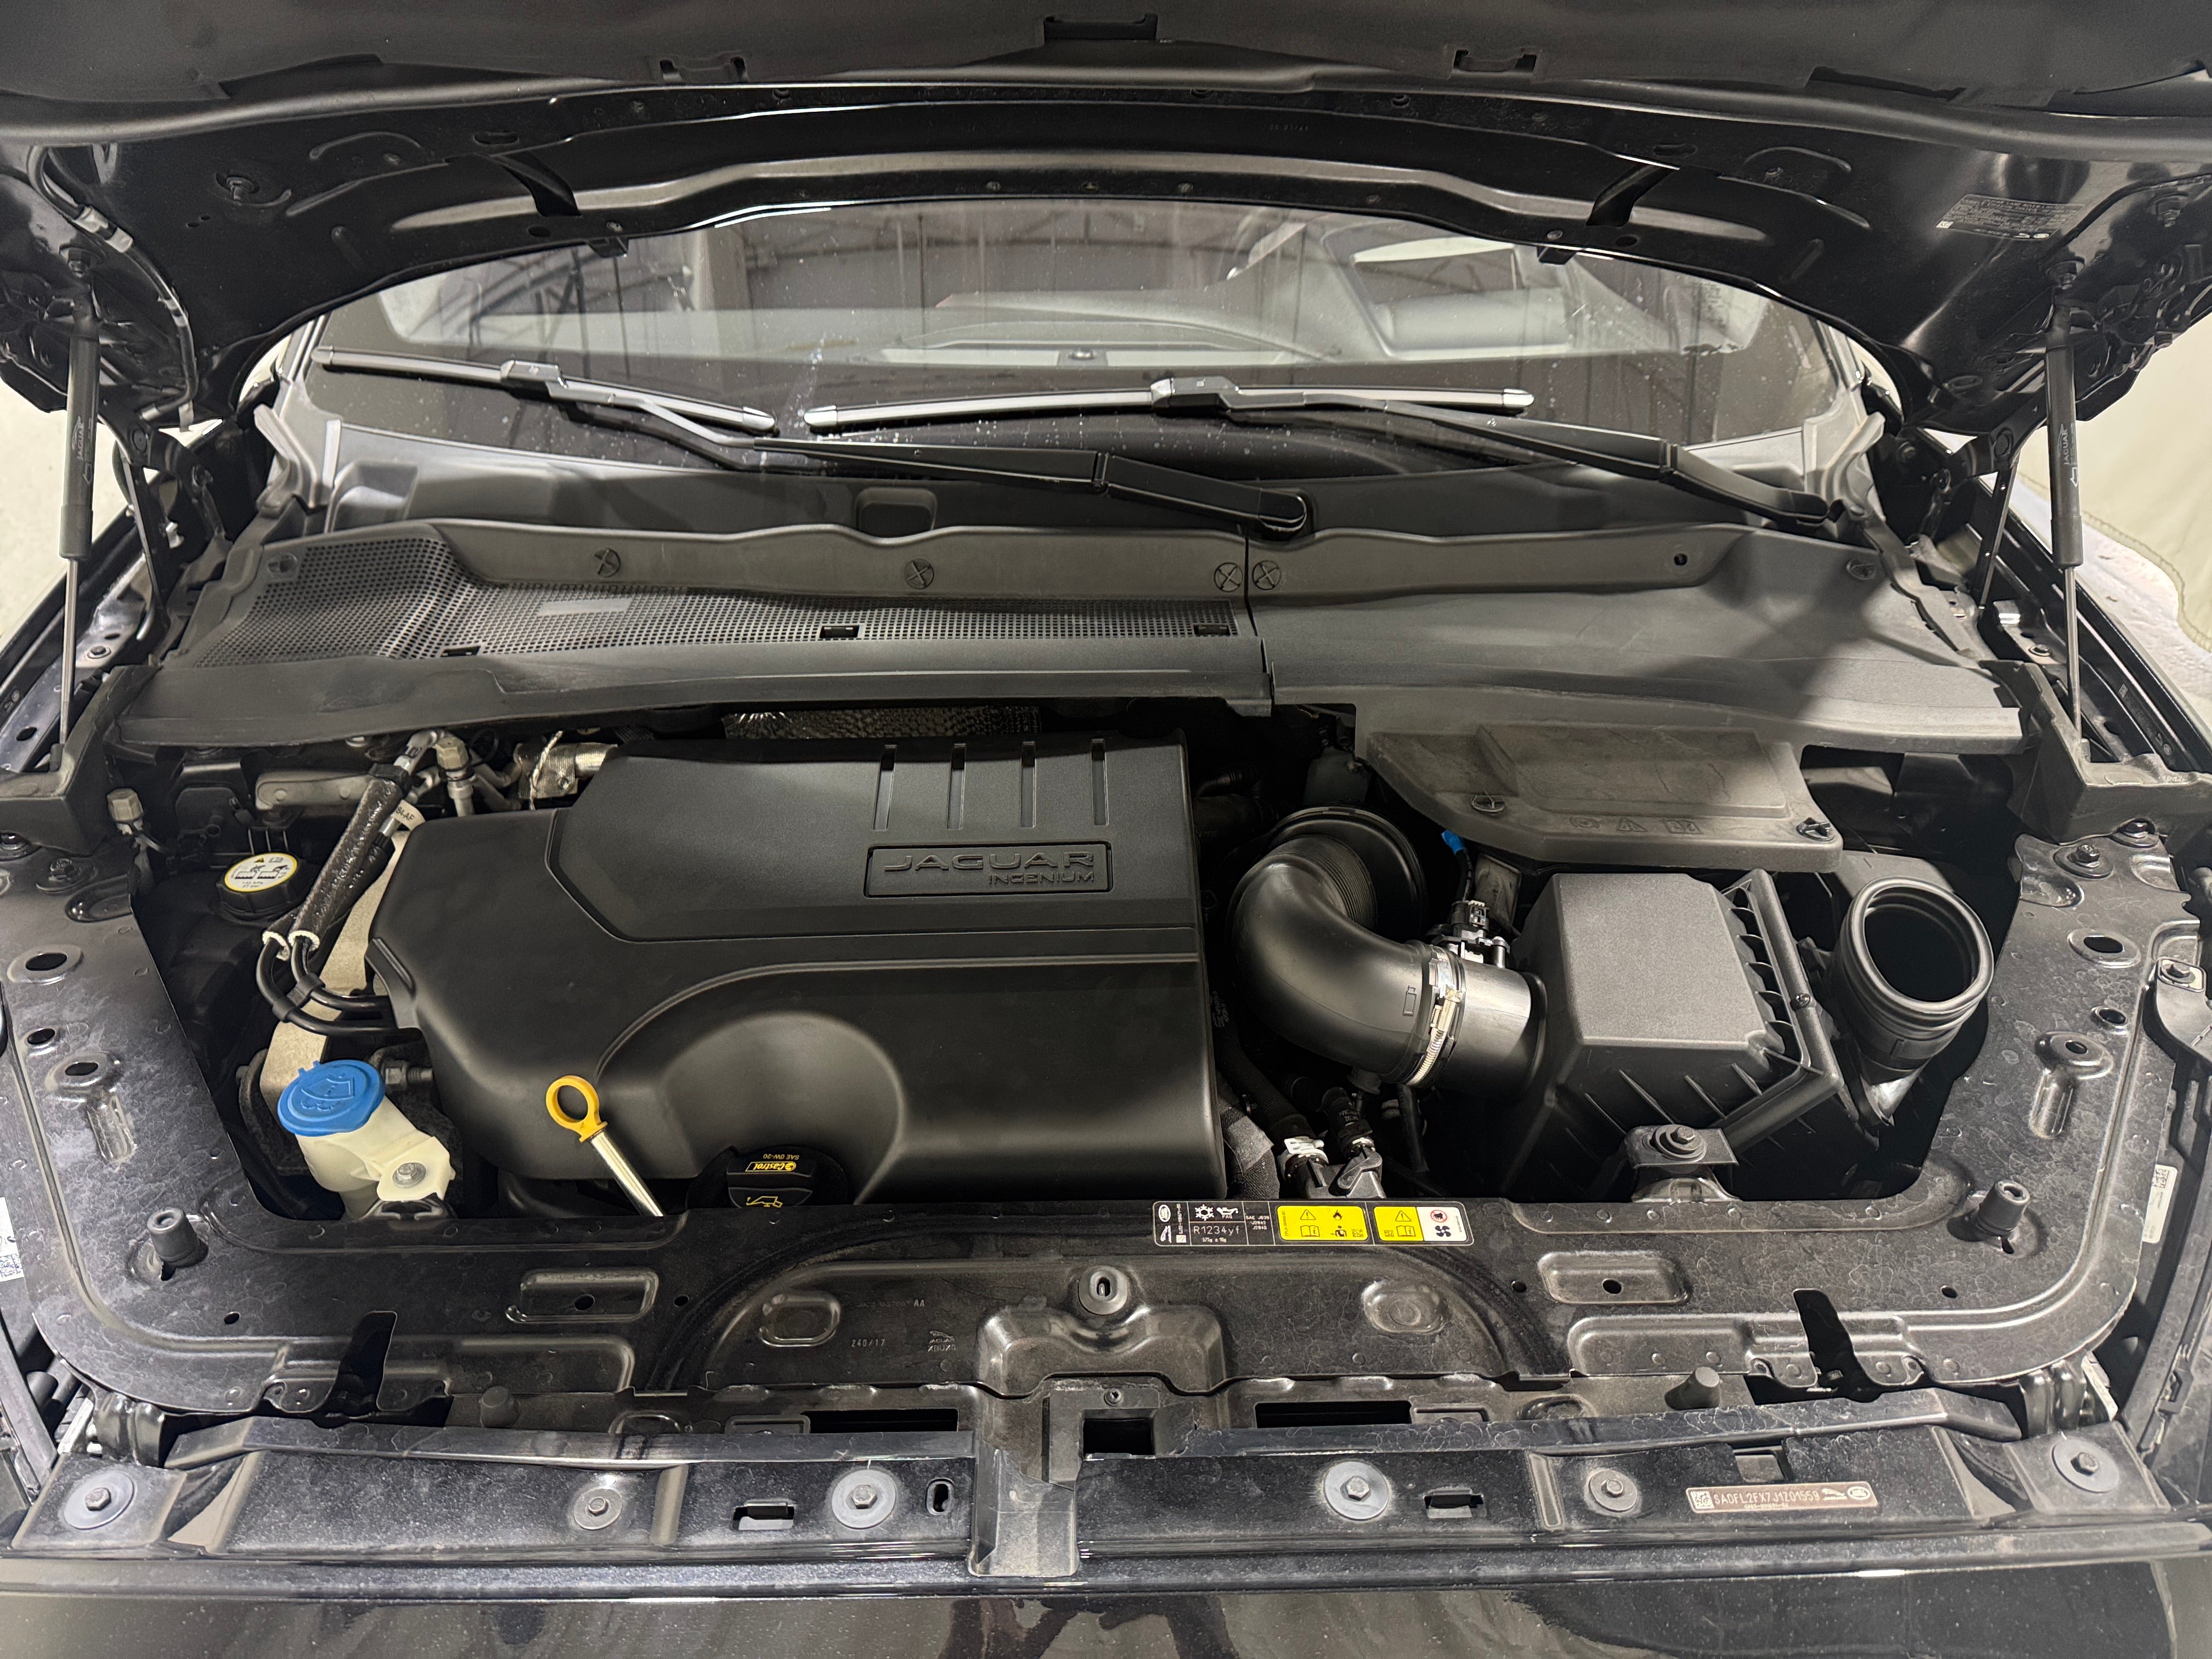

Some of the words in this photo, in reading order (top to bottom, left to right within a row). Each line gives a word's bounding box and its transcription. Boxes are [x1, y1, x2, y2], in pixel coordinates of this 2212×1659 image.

[77, 422, 85, 461] JAGUAR
[2062, 428, 2071, 466] JAGUAR
[884, 851, 1094, 871] JAGUAR
[988, 870, 1094, 884] INGENIUM
[753, 1162, 785, 1171] Castrol
[1193, 1225, 1240, 1236] R1234yf
